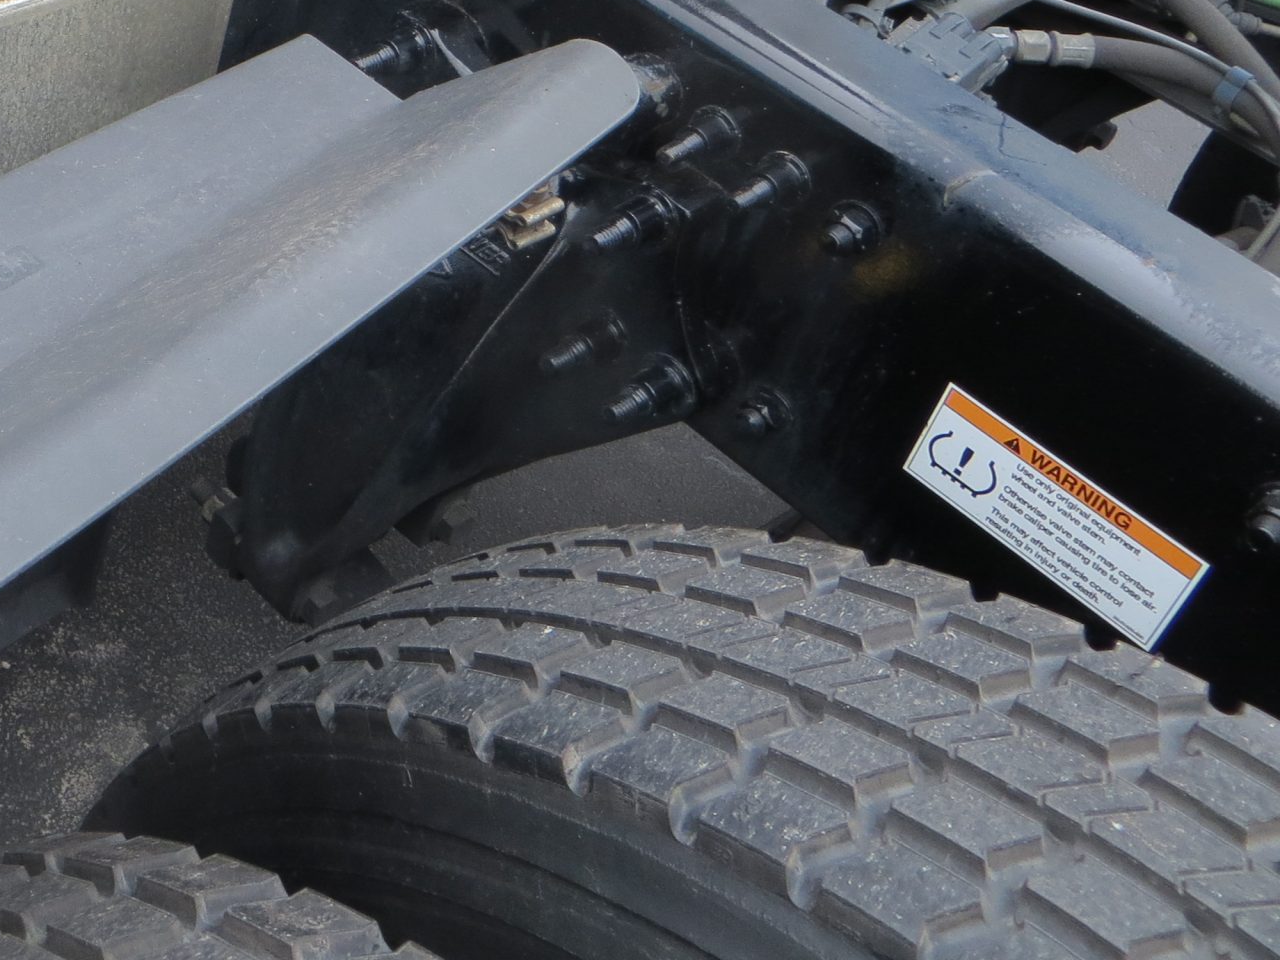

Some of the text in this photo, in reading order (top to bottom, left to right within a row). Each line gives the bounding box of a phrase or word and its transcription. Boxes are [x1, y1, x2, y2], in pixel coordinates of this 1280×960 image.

[1009, 470, 1108, 545] wheel and valve stem.
[1014, 462, 1142, 558] Use only original equipment
[1025, 447, 1135, 532] WARNING
[983, 513, 1102, 604] resulting in injury or death.
[989, 505, 1124, 608] This may affect vehicle control
[996, 492, 1160, 614] brake caliper causing tire to lose air.
[1001, 483, 1155, 599] Otherwise valve stem may contact
